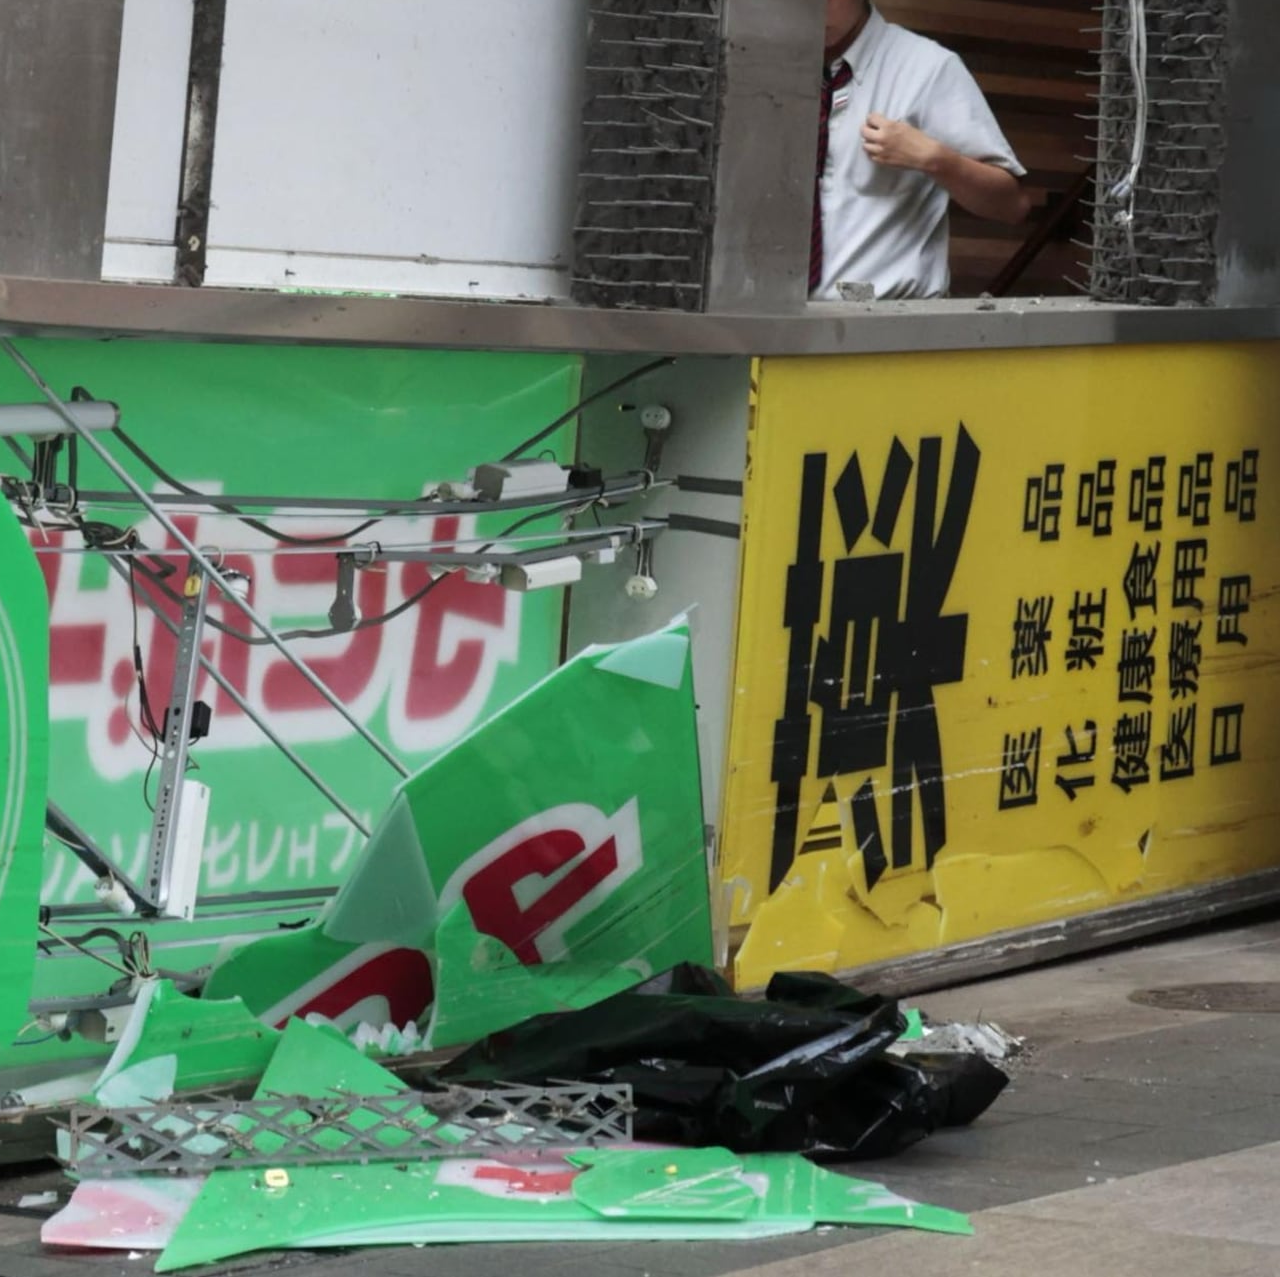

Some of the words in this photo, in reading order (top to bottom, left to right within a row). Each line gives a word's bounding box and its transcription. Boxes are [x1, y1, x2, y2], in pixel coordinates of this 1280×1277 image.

[999, 463, 1066, 811] 医薬品
[1055, 459, 1117, 801] 化粧品
[1110, 456, 1167, 795] 健康食品
[1160, 451, 1214, 782] 医療用品
[1210, 448, 1260, 766] 日用品
